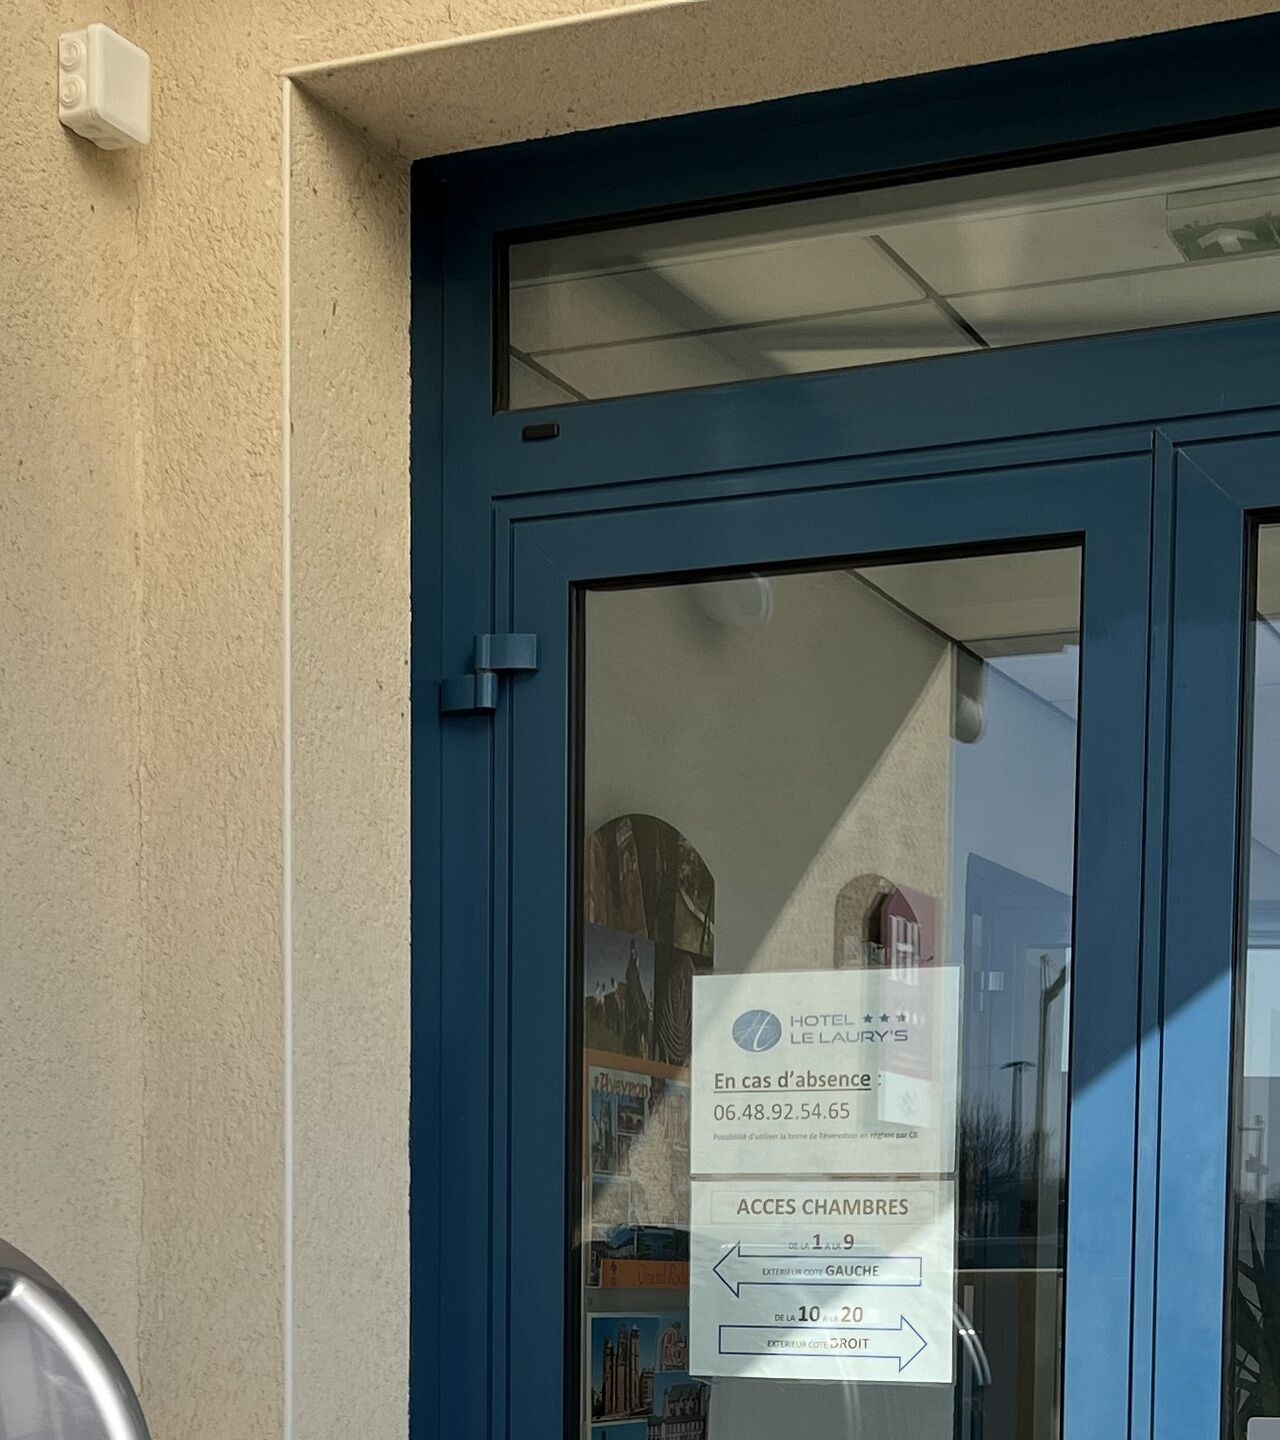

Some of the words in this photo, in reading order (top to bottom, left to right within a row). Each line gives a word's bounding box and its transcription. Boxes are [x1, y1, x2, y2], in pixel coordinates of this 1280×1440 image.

[790, 1014, 855, 1027] HOTEL
[790, 1033, 814, 1045] LE
[819, 1029, 908, 1044] LAURY'S
[714, 1073, 736, 1090] En
[742, 1075, 771, 1089] cas
[713, 1102, 851, 1121] 06.48.92.54.65
[736, 1198, 796, 1216] ACCES
[802, 1198, 909, 1216] CHAMBRES
[812, 1233, 823, 1250] 1
[843, 1233, 855, 1250] 9
[825, 1265, 880, 1277] GAUCHE
[774, 1313, 785, 1322] DE
[786, 1314, 796, 1322] LA
[798, 1305, 821, 1322] 10
[841, 1306, 864, 1323] 20
[830, 1337, 870, 1350] DROIT
